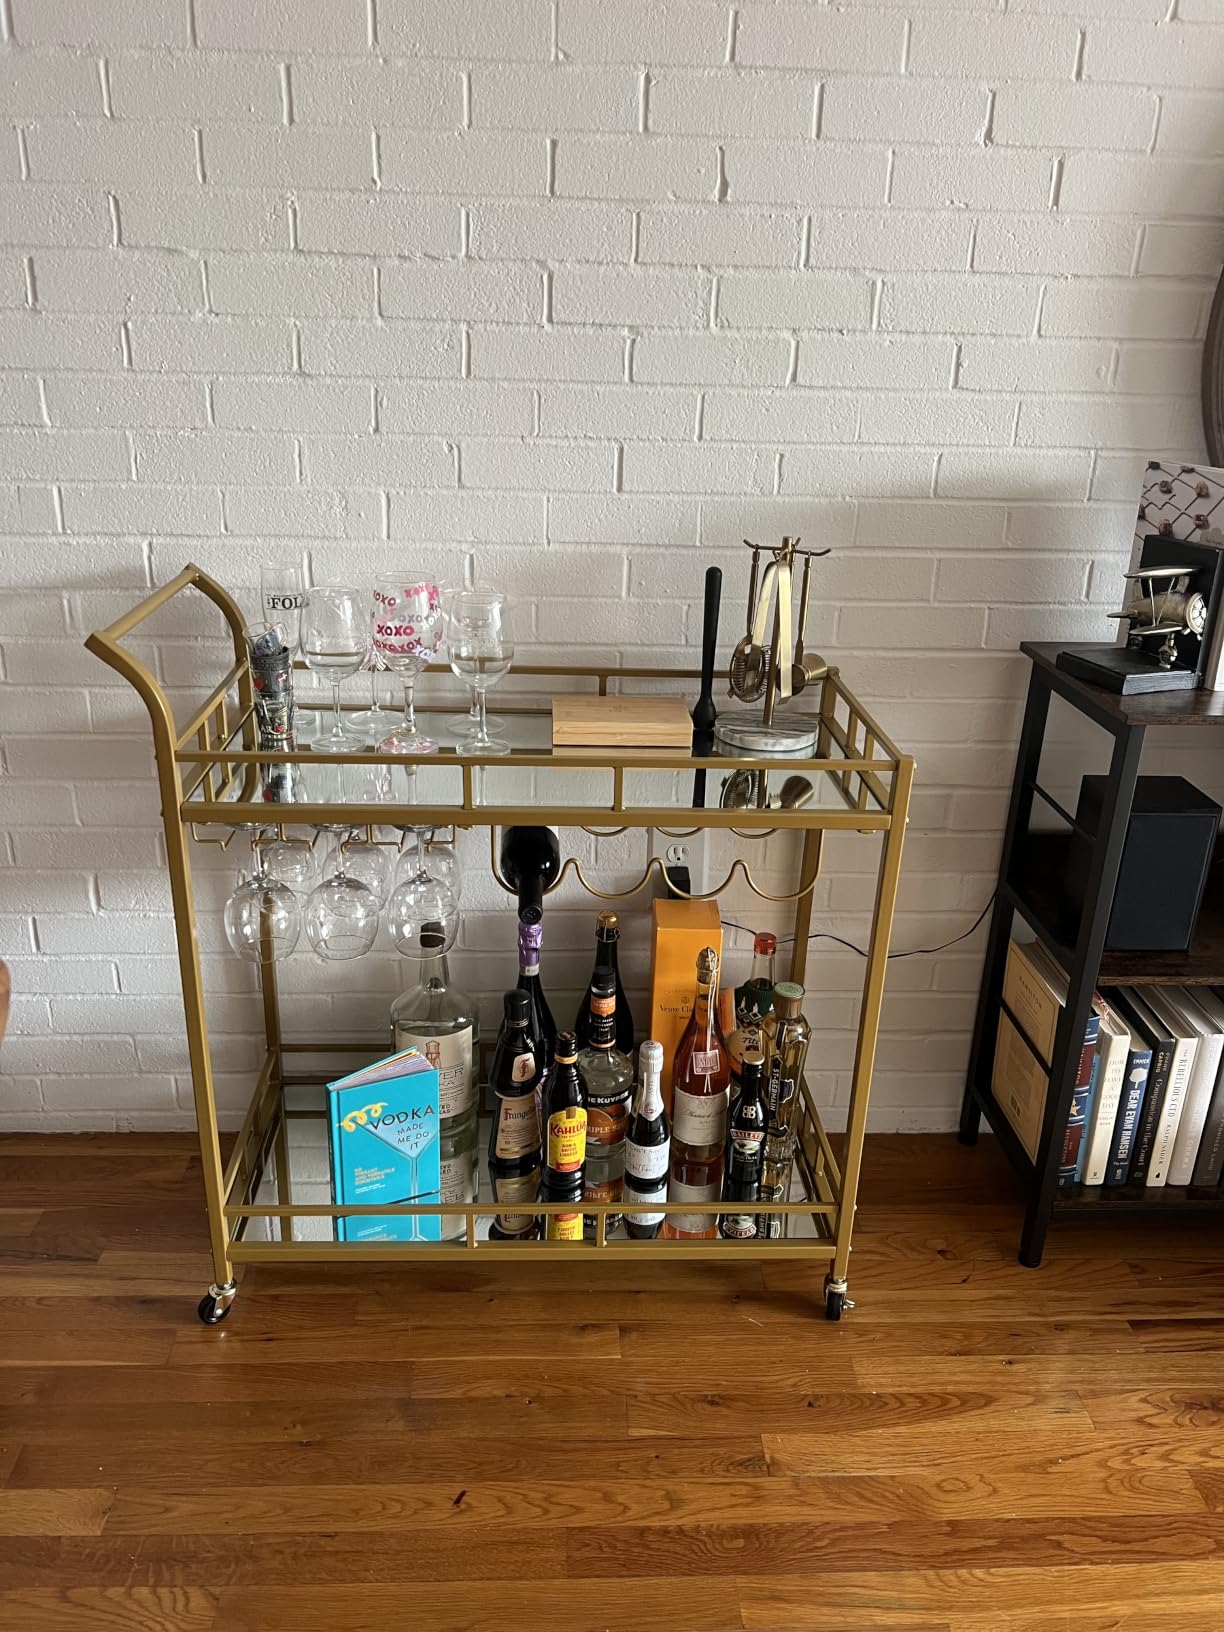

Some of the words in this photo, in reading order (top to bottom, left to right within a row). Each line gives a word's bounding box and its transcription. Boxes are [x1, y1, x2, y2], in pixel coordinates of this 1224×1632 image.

[376, 624, 415, 636] XOXO
[1156, 1051, 1164, 1073] CAPRIO
[769, 1068, 780, 1111] ST-GERMAIN
[1127, 1089, 1140, 1109] DEAR
[1147, 1078, 1163, 1123] Compassion
[369, 1104, 435, 1130] VODKA
[1123, 1110, 1136, 1129] EVAN
[397, 1122, 424, 1136] MADE
[397, 1134, 411, 1145] ME
[415, 1131, 430, 1140] DO
[1142, 1130, 1151, 1143] the
[409, 1141, 420, 1150] IT
[1117, 1130, 1132, 1159] HANSEN
[1138, 1143, 1150, 1165] Court
